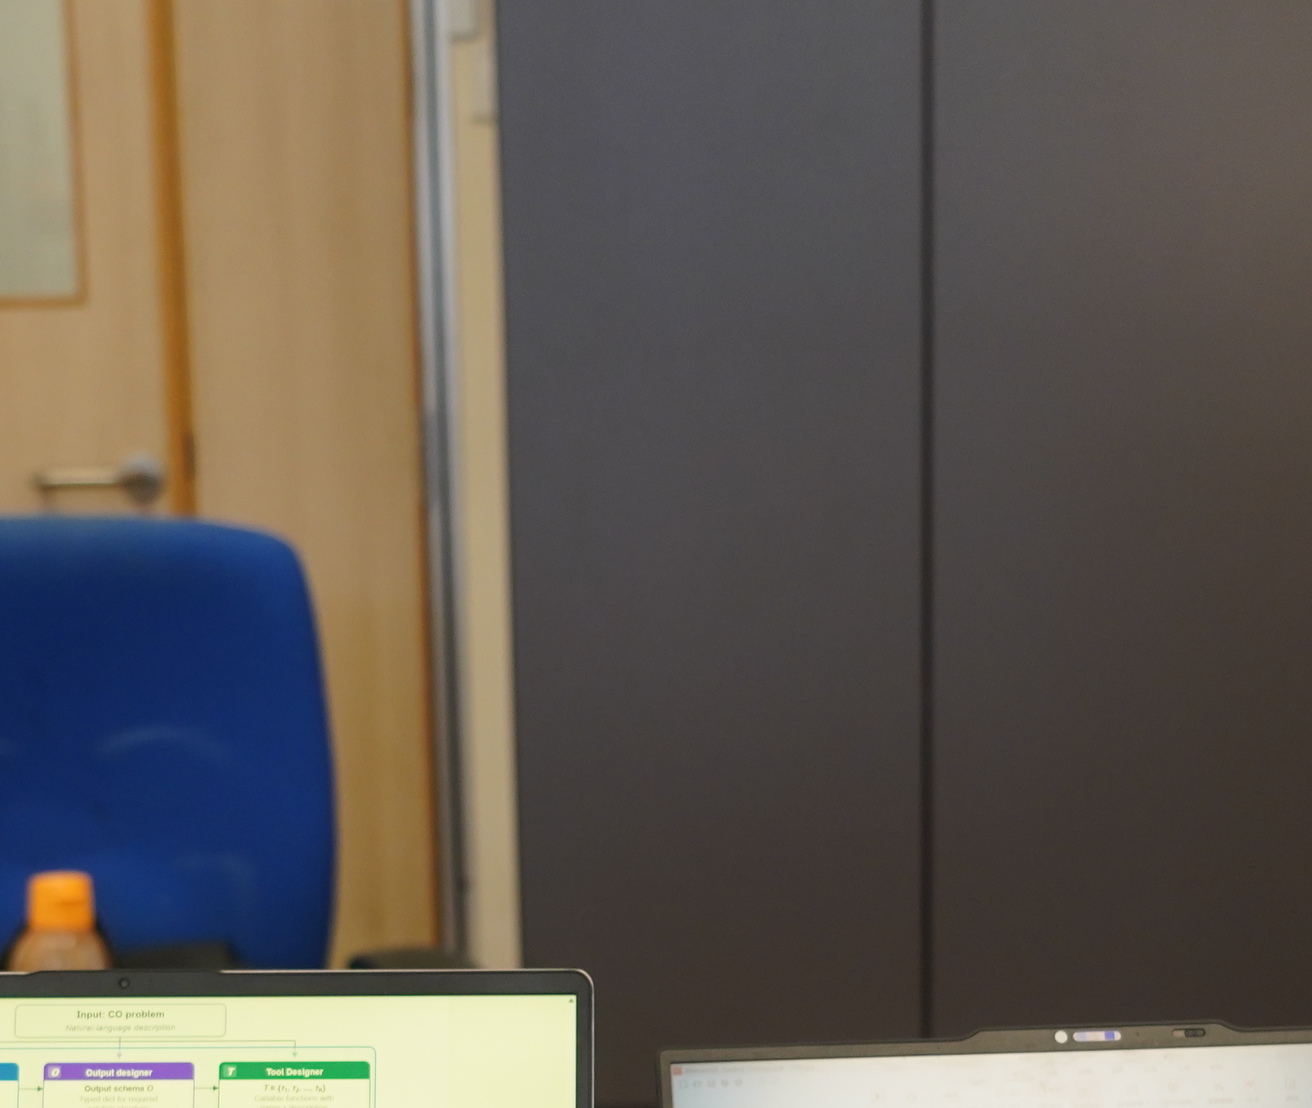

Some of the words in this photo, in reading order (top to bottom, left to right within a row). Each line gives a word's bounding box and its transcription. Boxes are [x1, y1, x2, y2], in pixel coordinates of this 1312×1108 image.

[77, 1010, 104, 1020] Input:
[108, 1010, 122, 1018] CO
[126, 1010, 165, 1019] problem
[134, 1024, 175, 1032] description
[86, 1068, 115, 1077] Output
[116, 1068, 153, 1077] designer
[266, 1068, 285, 1076] Tool
[287, 1068, 324, 1076] Designer
[84, 1085, 111, 1093] Output
